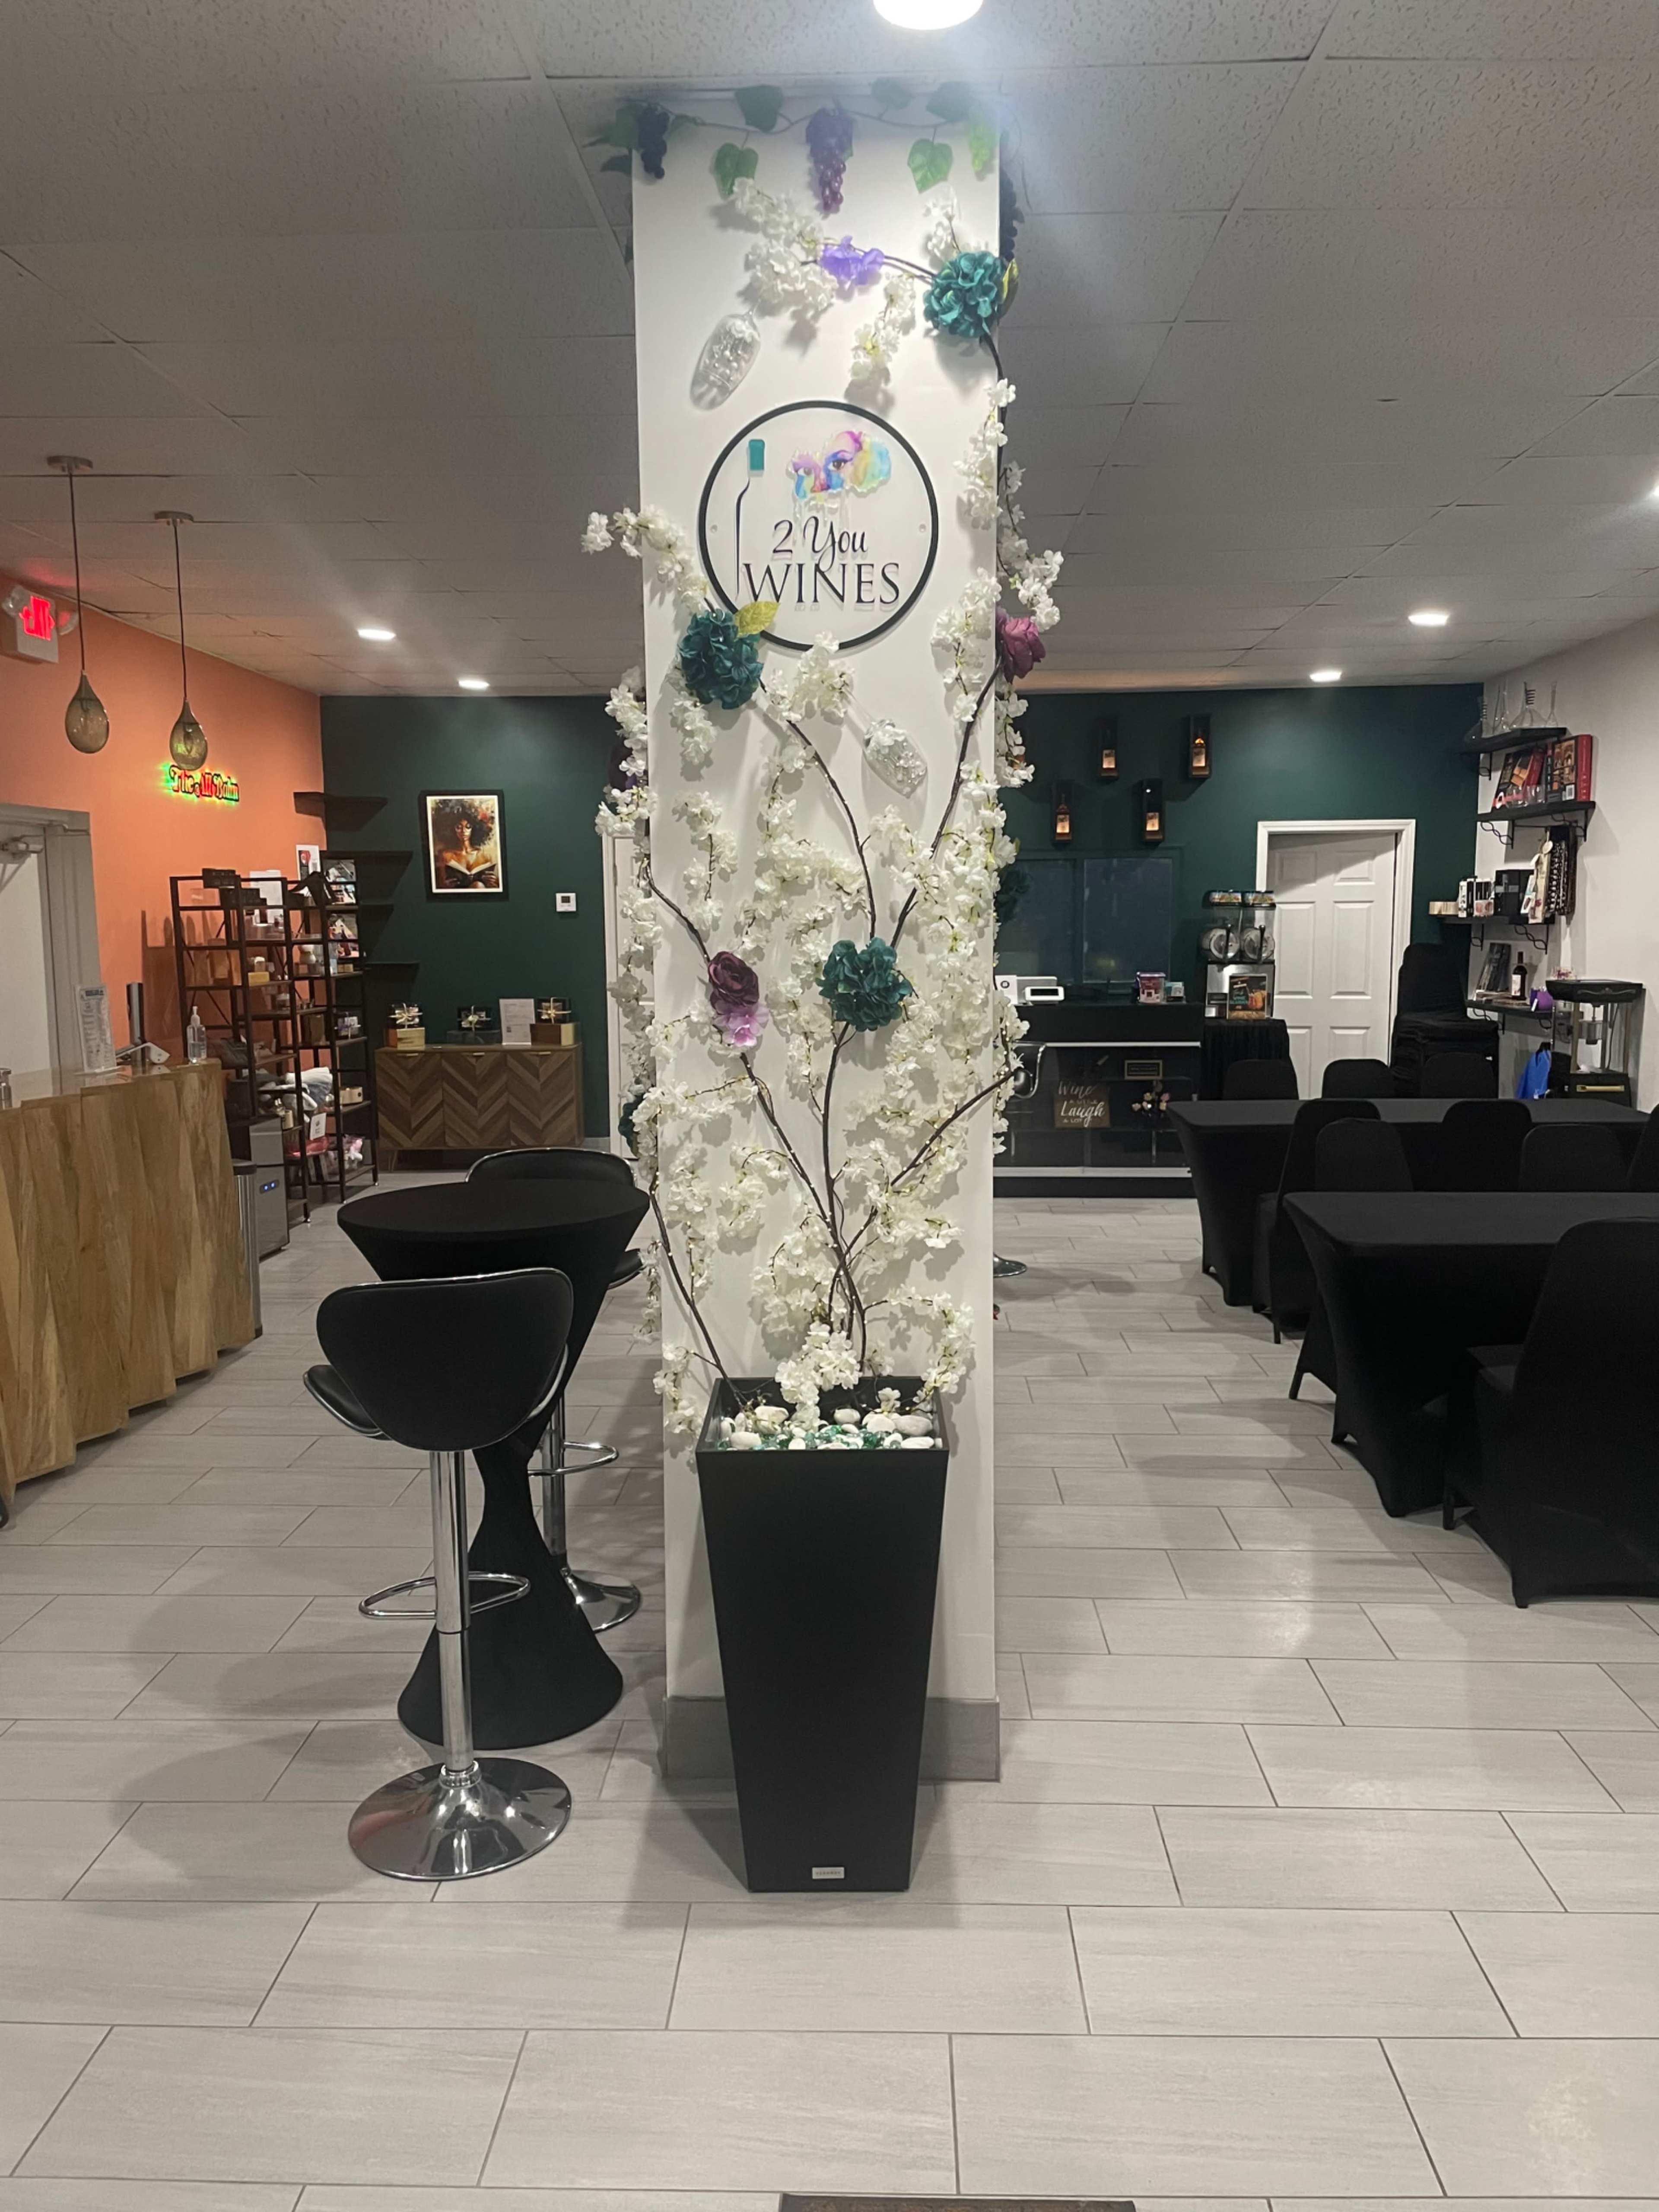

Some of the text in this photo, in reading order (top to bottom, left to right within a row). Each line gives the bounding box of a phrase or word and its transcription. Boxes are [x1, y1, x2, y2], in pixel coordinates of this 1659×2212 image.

[772, 516, 868, 573] 2 You
[743, 562, 900, 604] WINES
[1058, 1081, 1098, 1099] Wine
[1061, 1100, 1105, 1128] Laugh
